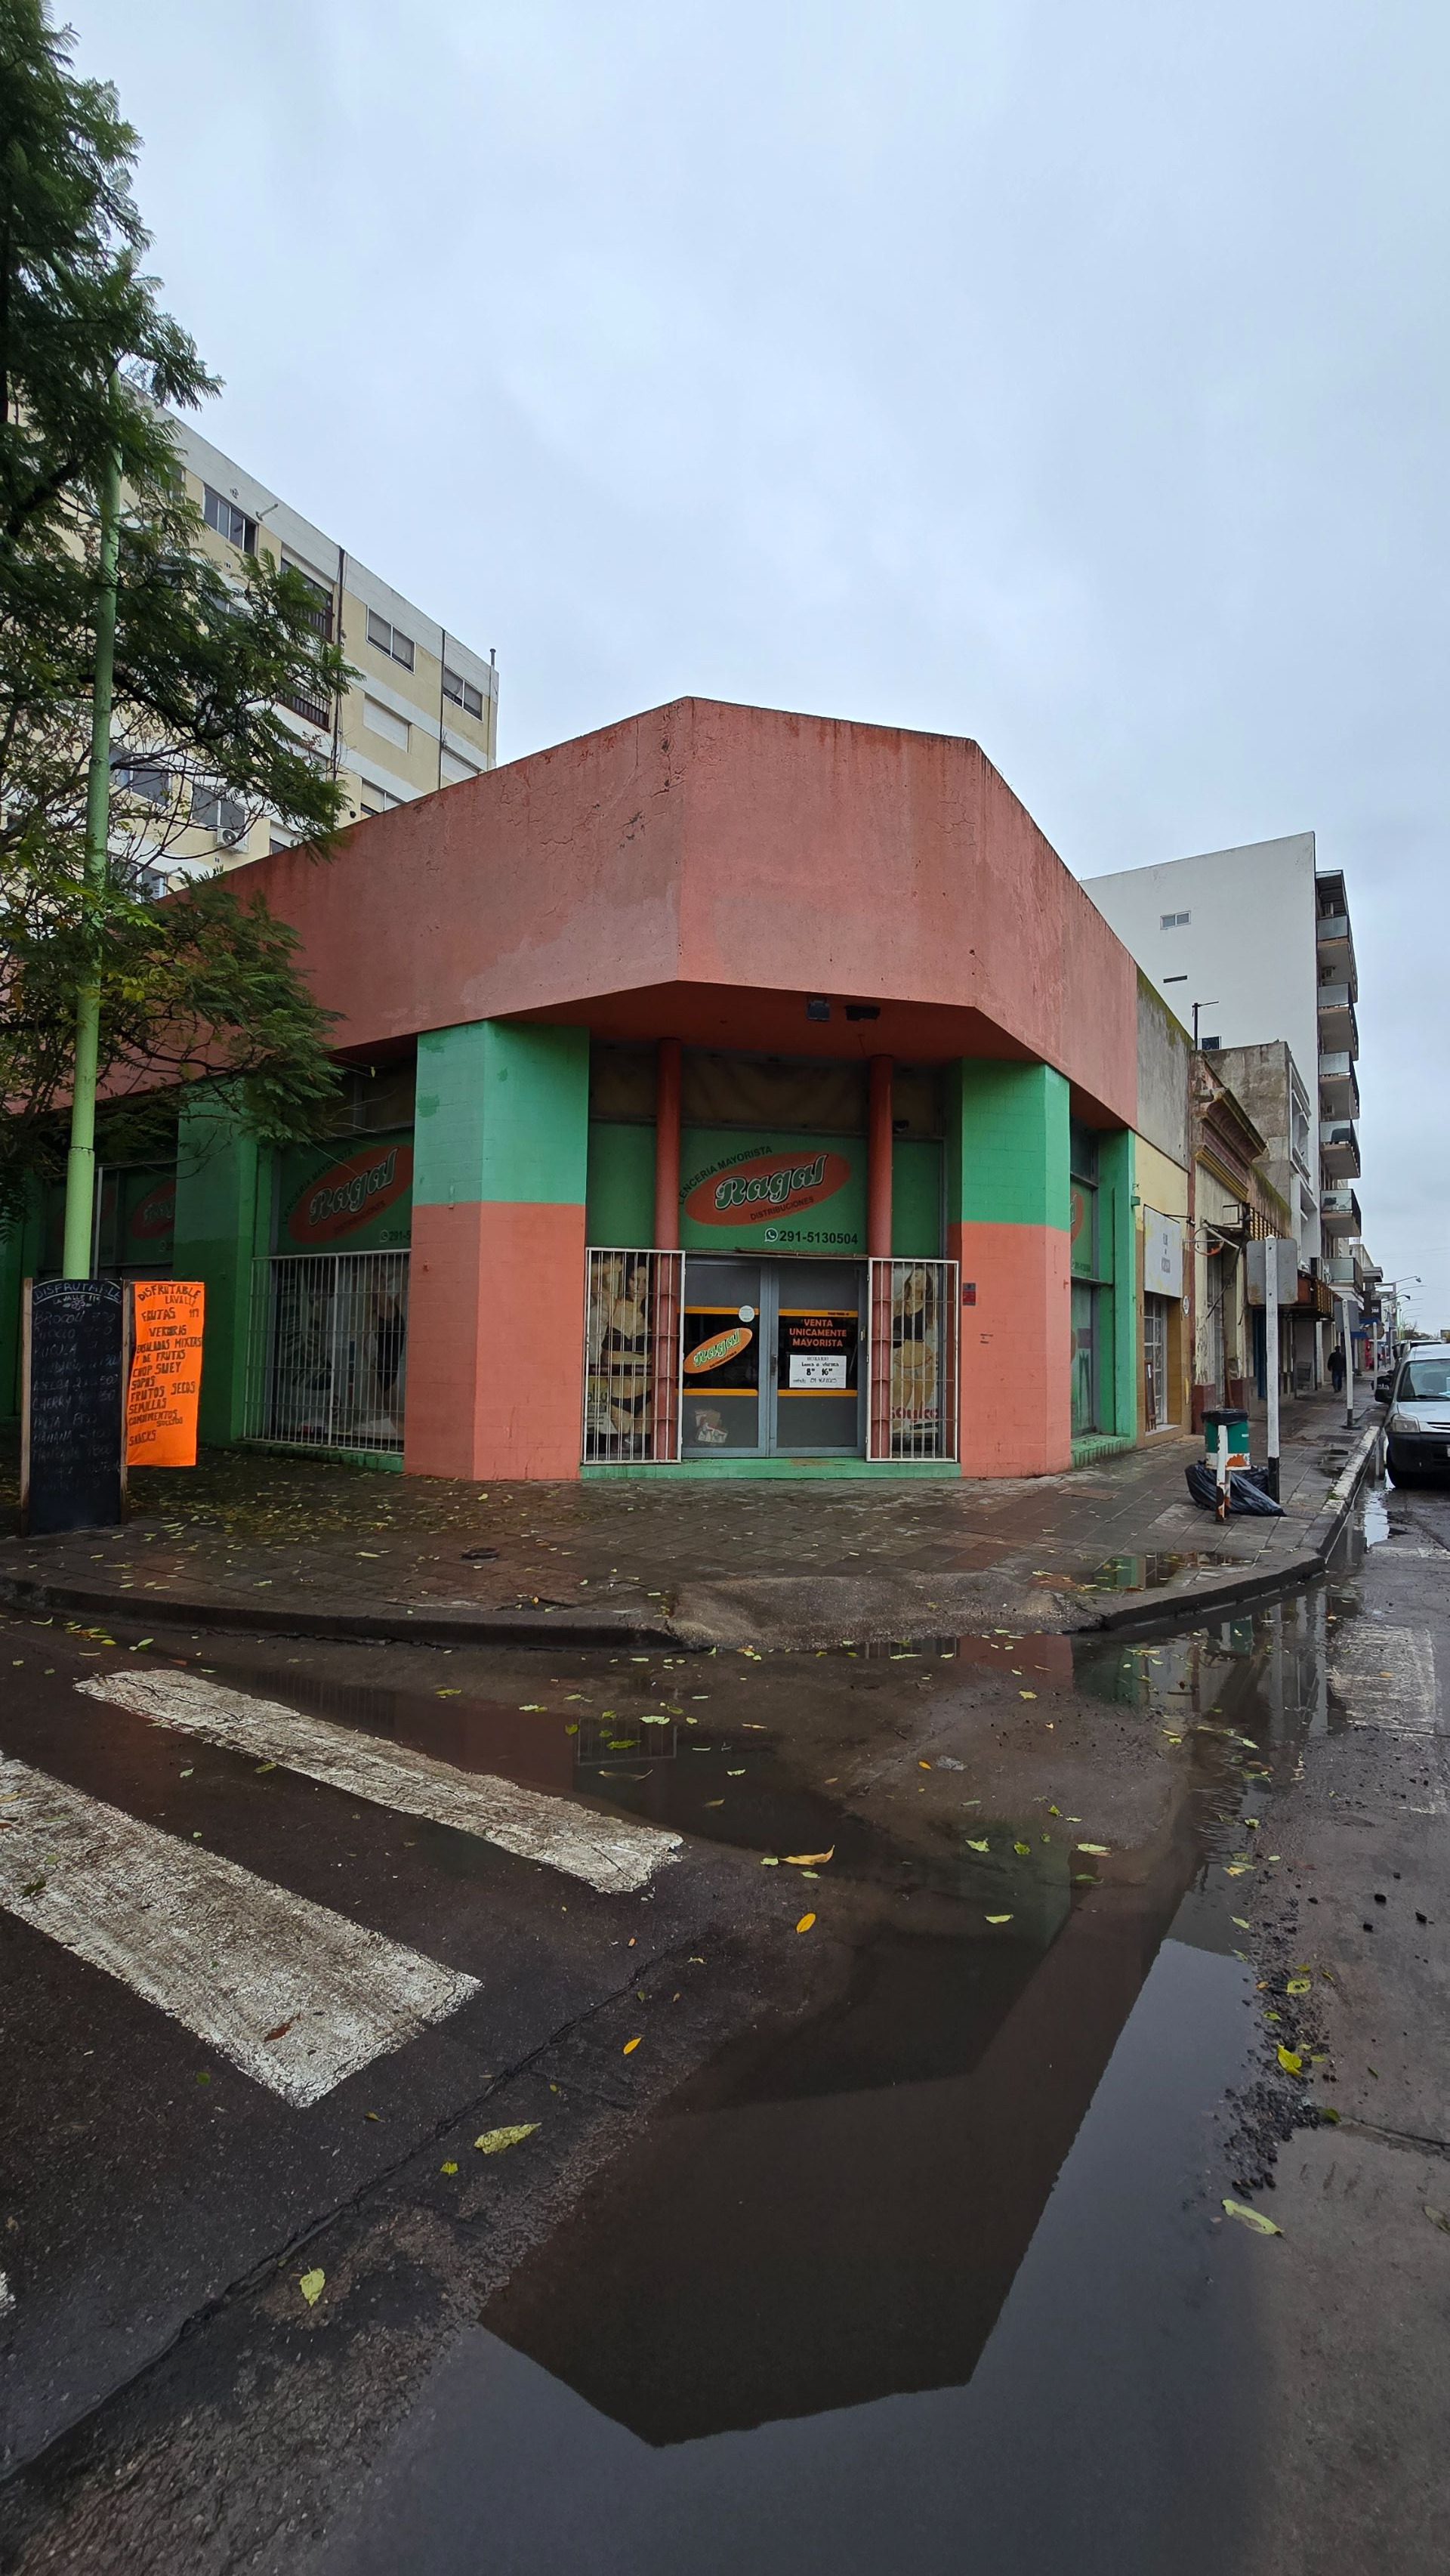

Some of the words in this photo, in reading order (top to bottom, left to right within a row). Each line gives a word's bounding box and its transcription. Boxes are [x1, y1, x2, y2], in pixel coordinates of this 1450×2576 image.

[678, 1165, 717, 1205] LENCERIA
[717, 1145, 773, 1170] MAYORISTA
[714, 1154, 828, 1210] Ragal
[308, 1147, 400, 1227] Ragal
[750, 1196, 814, 1220] DISTRIBUCIONES
[779, 1230, 859, 1245] 291-5130504
[137, 1284, 201, 1301] DISFRUTABLE
[141, 1307, 176, 1322] FRUTAS
[804, 1318, 833, 1327] VENTA
[789, 1328, 847, 1337] UNICAMENTE
[792, 1338, 843, 1347] MAYORISTA
[156, 1349, 186, 1361] FRUTAS
[154, 1361, 182, 1374] SUEY
[131, 1376, 156, 1390] SOPAS
[131, 1385, 165, 1402] FRUTOS
[171, 1381, 196, 1395] SECOS
[32, 1395, 72, 1413] CHERRY
[128, 1398, 167, 1415] SEMILLAS
[128, 1429, 156, 1446] SNACKS
